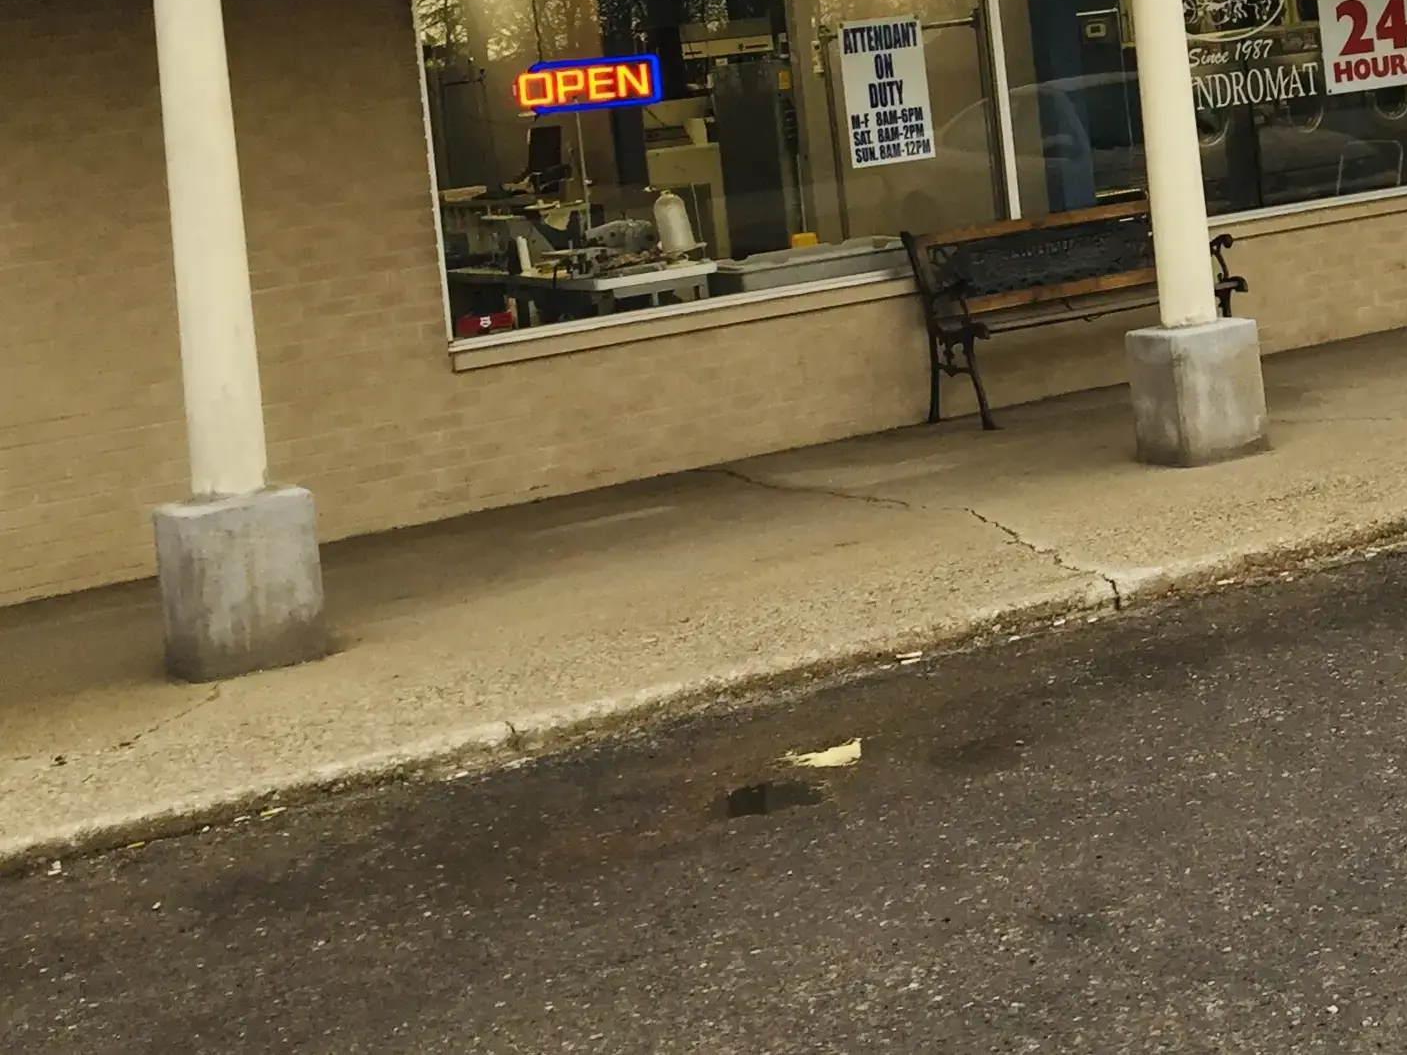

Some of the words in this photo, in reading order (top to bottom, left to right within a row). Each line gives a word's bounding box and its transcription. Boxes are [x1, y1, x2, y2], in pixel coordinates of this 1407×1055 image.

[843, 22, 917, 54] ATTENDANT
[874, 53, 894, 80] ON
[1189, 48, 1230, 68] Since
[1234, 39, 1274, 61] 1987
[517, 62, 651, 107] OPEN
[868, 80, 904, 109] DUTY
[1191, 62, 1318, 110] NDROMAT
[851, 113, 869, 130] M-F
[875, 107, 924, 127] 8AM-6PM
[877, 123, 925, 144] 8AM-2PM
[855, 146, 879, 164] SUN.
[879, 139, 931, 160] 8AM-12PM
